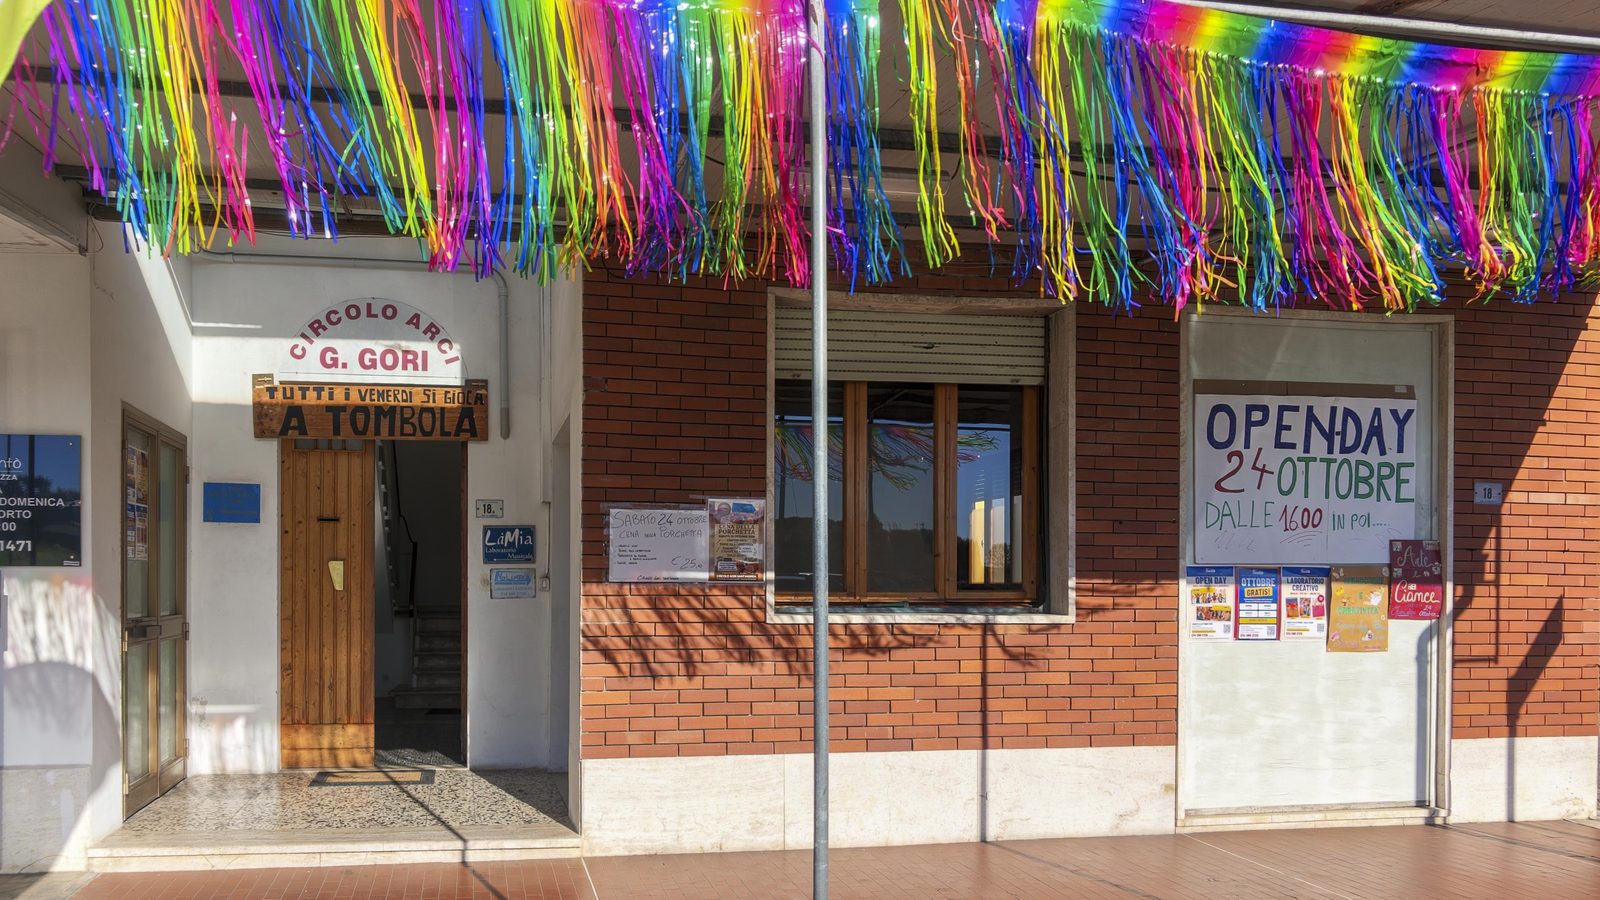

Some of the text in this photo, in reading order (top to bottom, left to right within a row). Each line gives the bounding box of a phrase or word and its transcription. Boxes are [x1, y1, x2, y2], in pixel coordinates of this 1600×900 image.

[290, 302, 460, 366] CIRCOLO ARCI
[319, 346, 429, 372] G. GORI
[278, 405, 479, 438] A TOMBOLA
[1214, 447, 1415, 503] 24 OTTOBRE
[1483, 487, 1493, 500] 18
[611, 511, 708, 529] SABATO 24 OTTOBRE
[1205, 500, 1275, 531] DALLE
[619, 529, 640, 539] CENA
[660, 526, 702, 539] PORCHETTA
[1195, 576, 1212, 584] OPEN
[1241, 577, 1276, 587] OTTOBRE
[1246, 588, 1271, 597] GRATIS!
